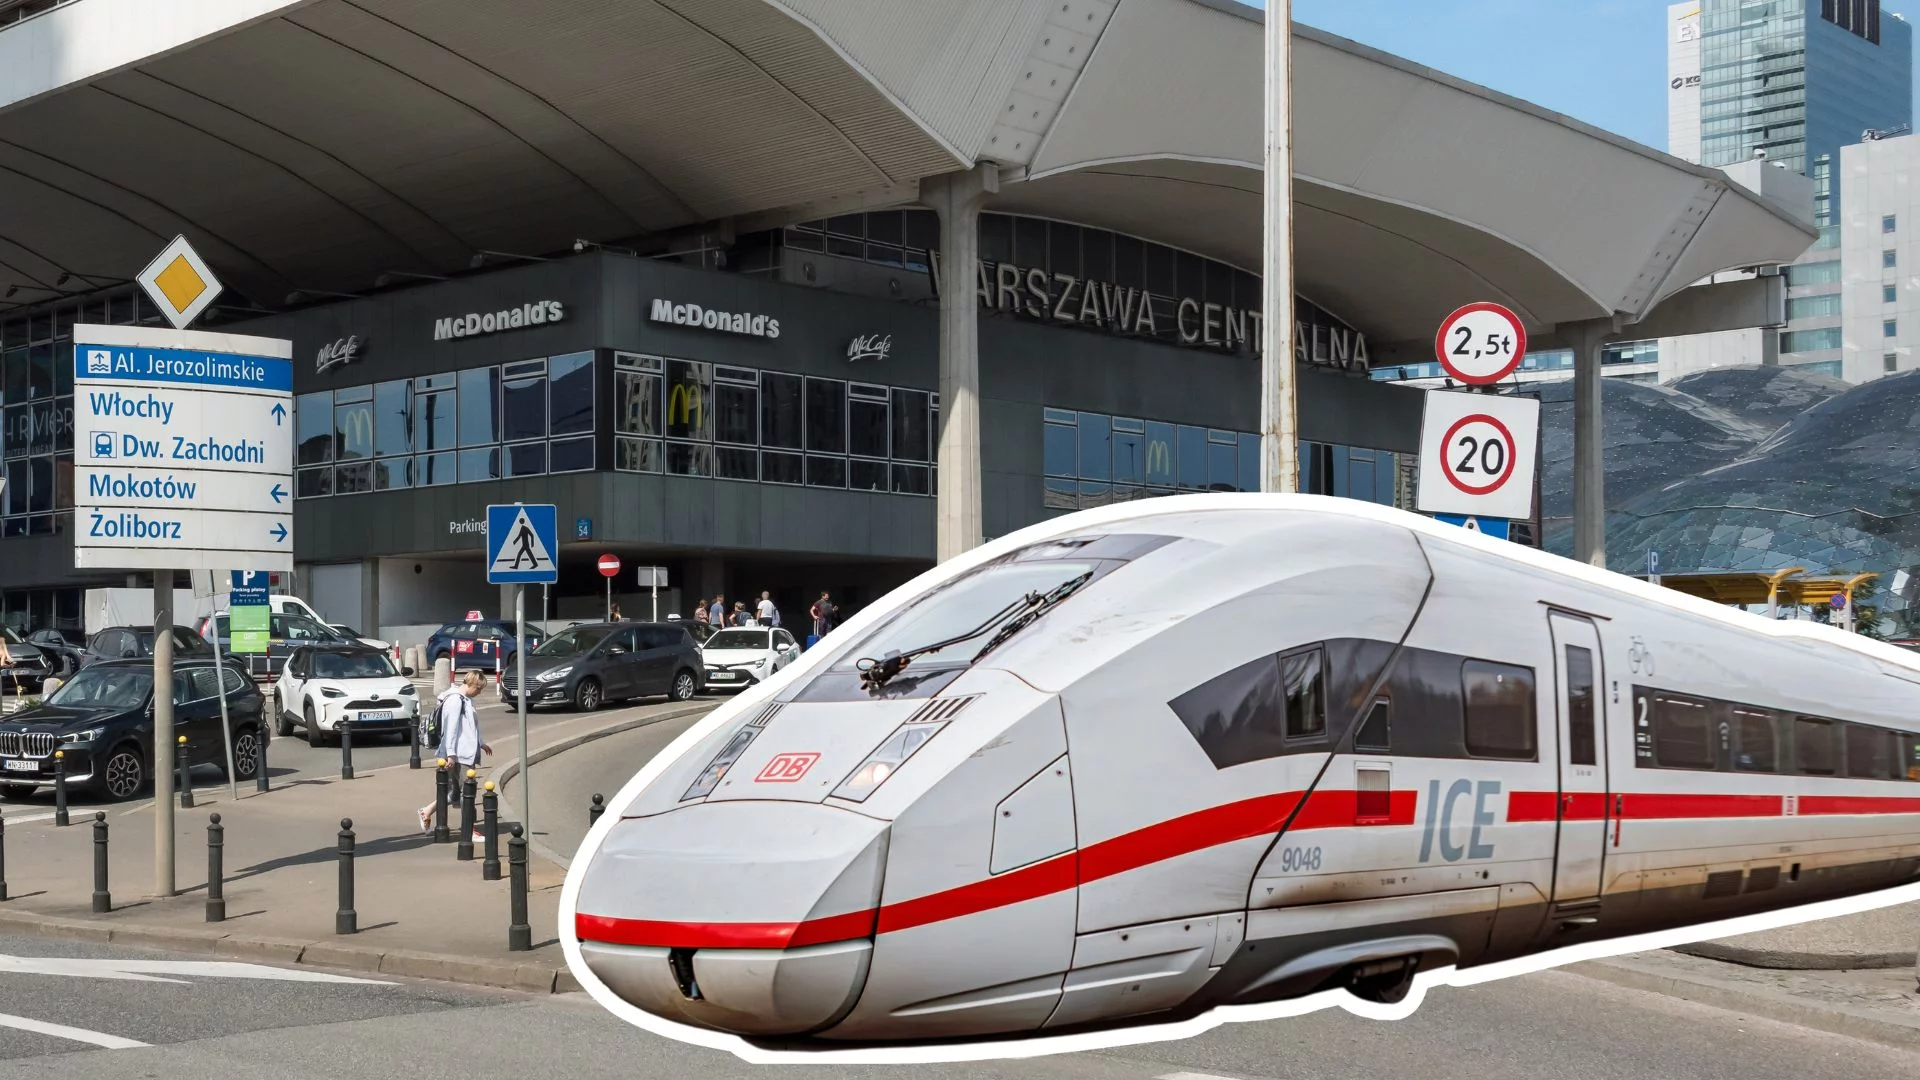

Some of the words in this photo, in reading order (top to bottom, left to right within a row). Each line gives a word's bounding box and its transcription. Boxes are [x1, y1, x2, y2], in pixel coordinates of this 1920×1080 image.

[434, 300, 563, 340] McDonald's
[651, 299, 780, 339] McDonald's
[929, 248, 1157, 335] ARSZAWA
[1177, 296, 1370, 371] CENTALNA
[1452, 326, 1510, 360] 2,5t
[115, 352, 140, 373] Al.
[146, 354, 265, 382] Jerozolimskie
[89, 391, 174, 425] Włochy
[123, 434, 164, 458] Dw.
[172, 436, 264, 464] Zachodni
[1455, 435, 1504, 476] 20
[89, 473, 197, 499] Mokotów
[89, 507, 182, 539] Żoliborz
[450, 518, 487, 535] Parking
[578, 525, 588, 537] 54
[1638, 696, 1649, 727] 2
[763, 757, 810, 777] DB
[1418, 778, 1502, 863] ICE
[1282, 846, 1322, 872] 9048
